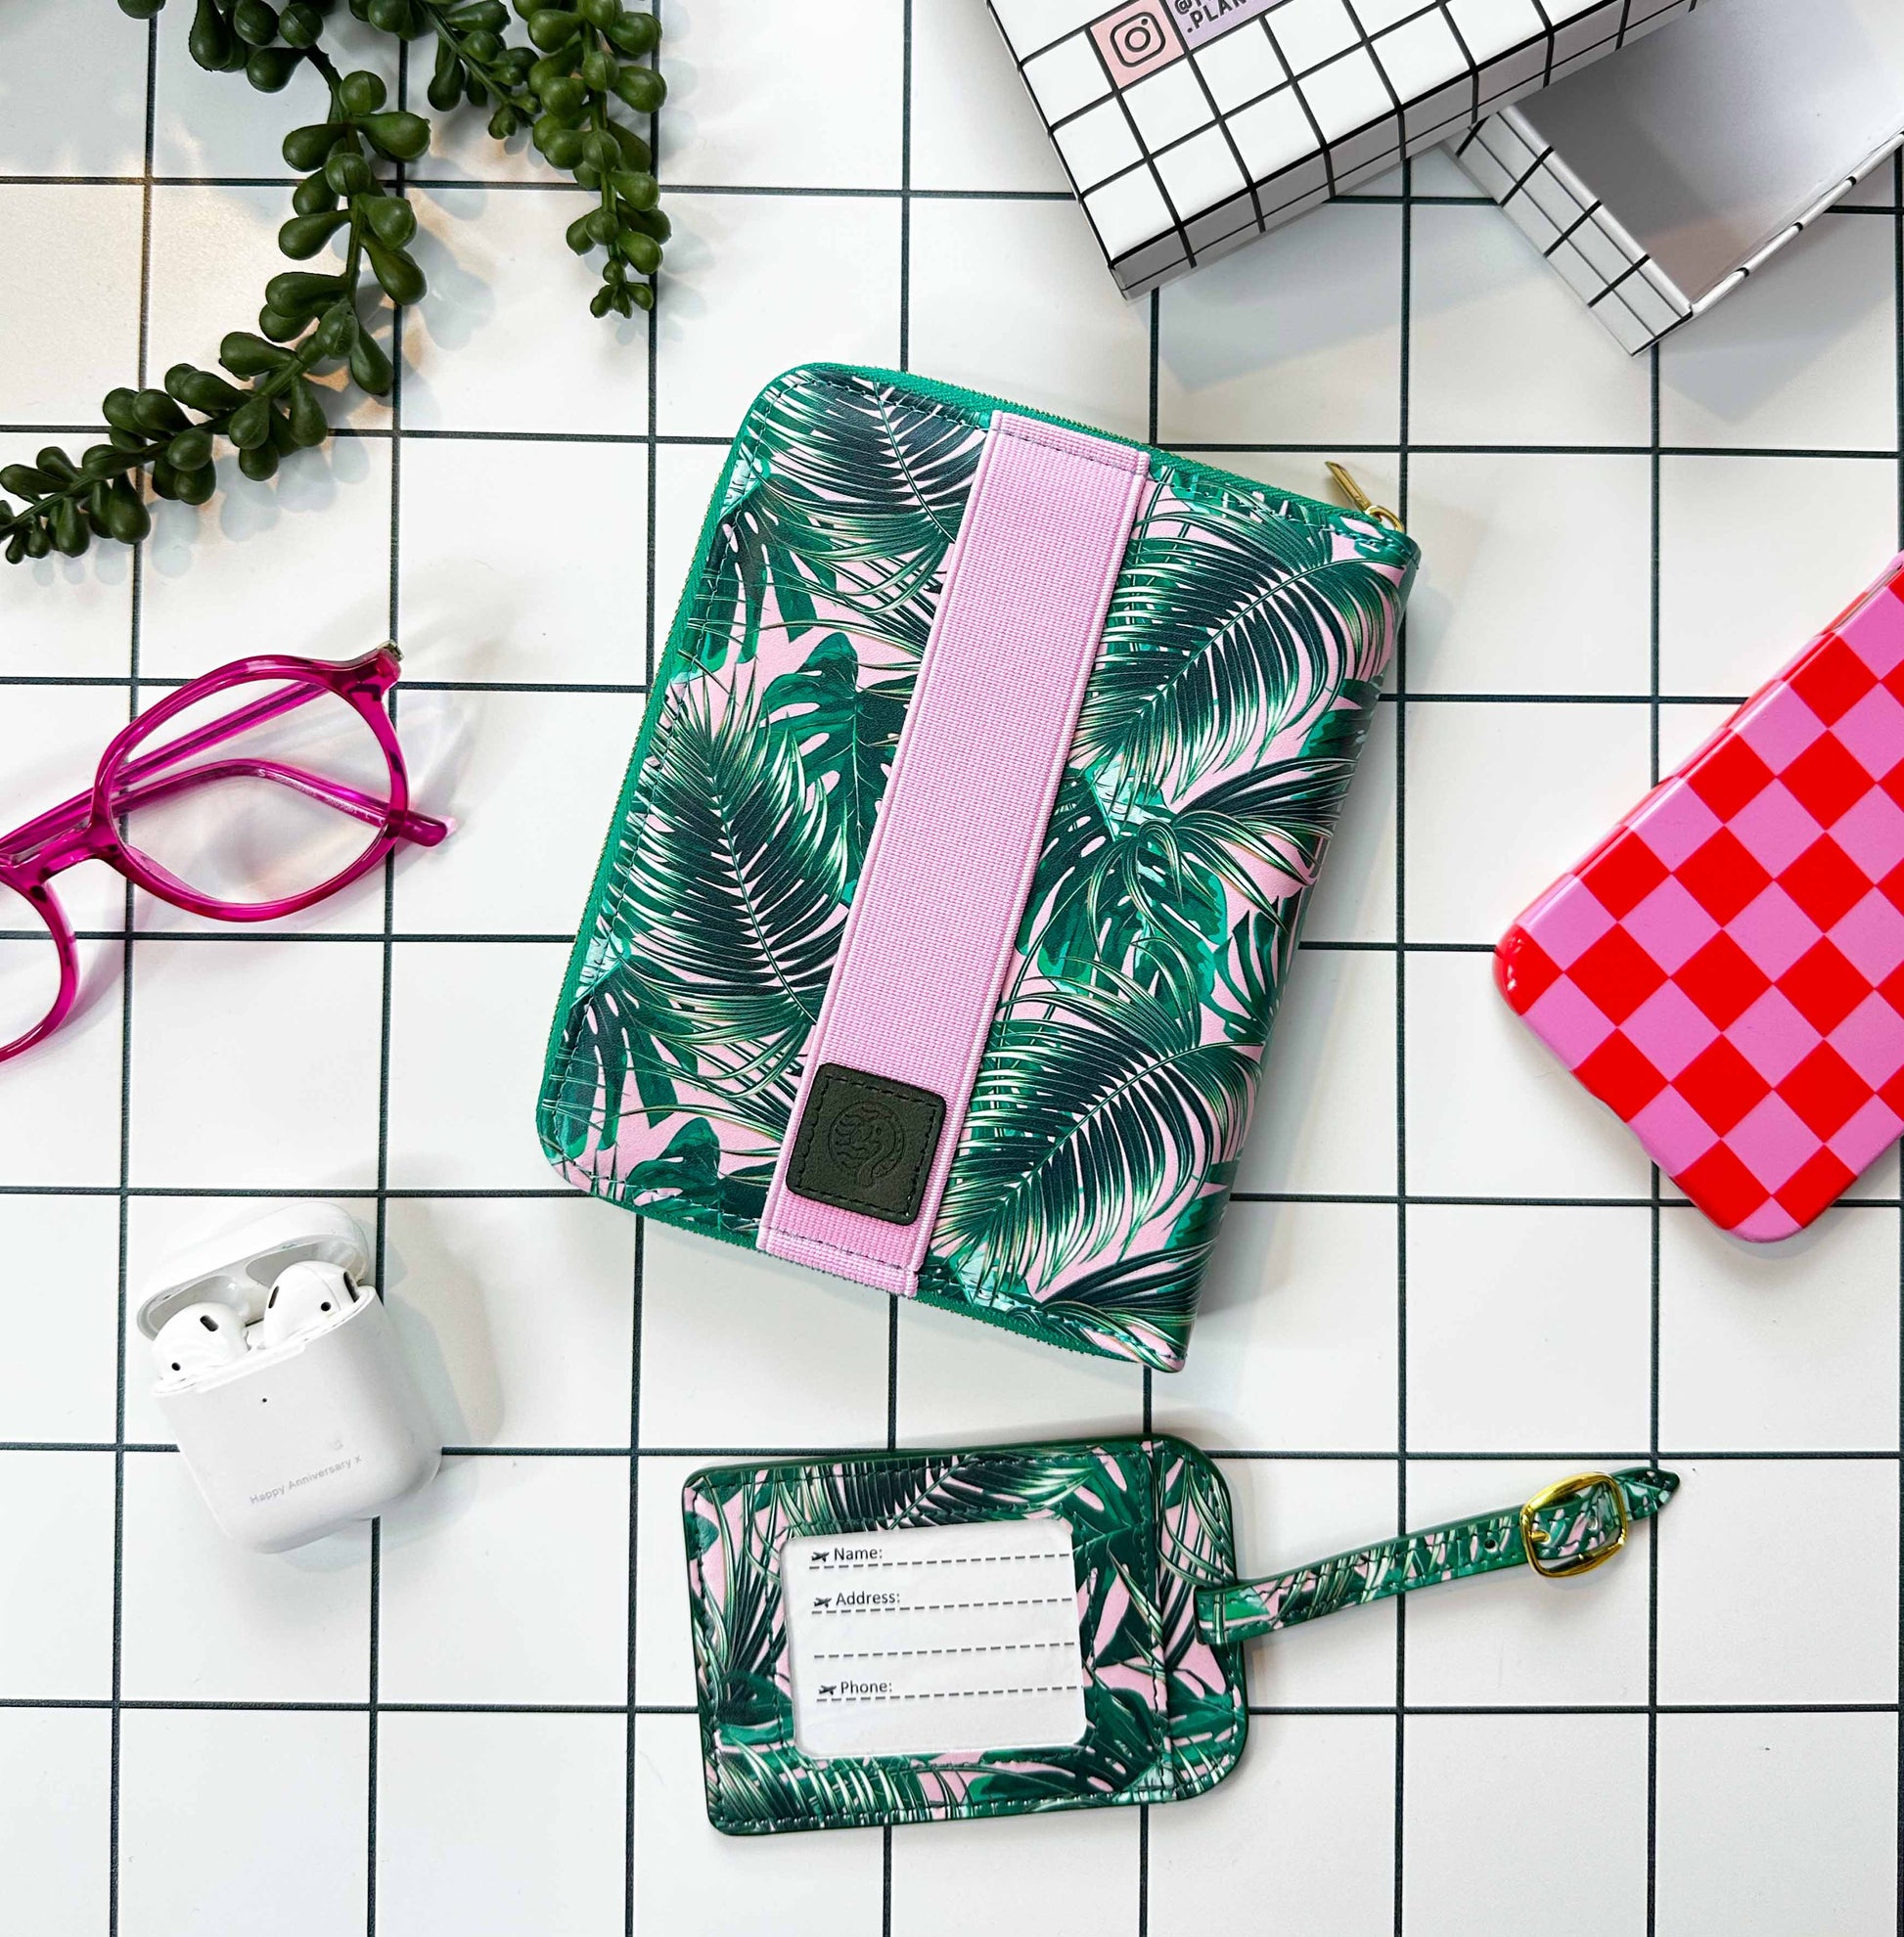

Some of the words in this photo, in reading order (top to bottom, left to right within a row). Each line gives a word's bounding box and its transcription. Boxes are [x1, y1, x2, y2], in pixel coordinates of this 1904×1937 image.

[249, 1484, 286, 1505] Happy
[289, 1458, 352, 1490] Anniversary
[834, 1547, 883, 1561] Name:
[836, 1590, 900, 1605] Address:
[840, 1680, 892, 1694] Phone:
